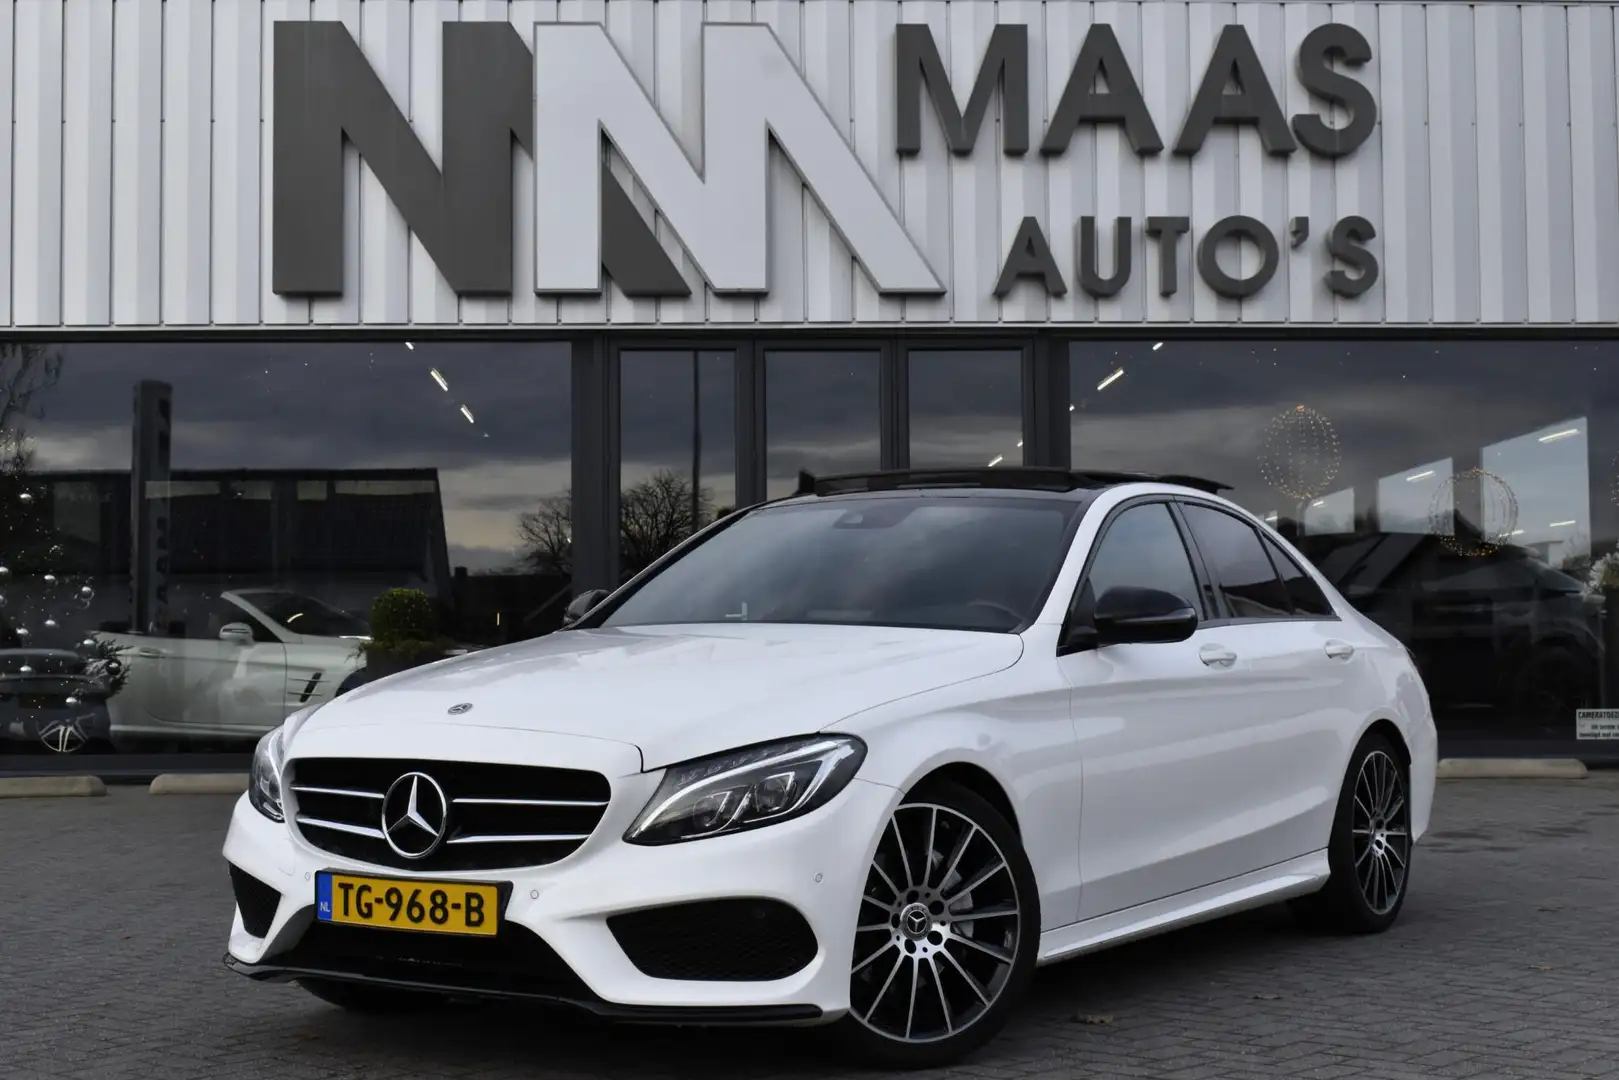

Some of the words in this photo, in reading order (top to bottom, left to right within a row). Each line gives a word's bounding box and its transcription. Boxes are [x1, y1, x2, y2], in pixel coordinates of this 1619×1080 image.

[895, 22, 1378, 158] MAAS
[993, 214, 1380, 300] AUTO'S
[320, 901, 331, 913] NL
[338, 882, 485, 928] TG-968-B
